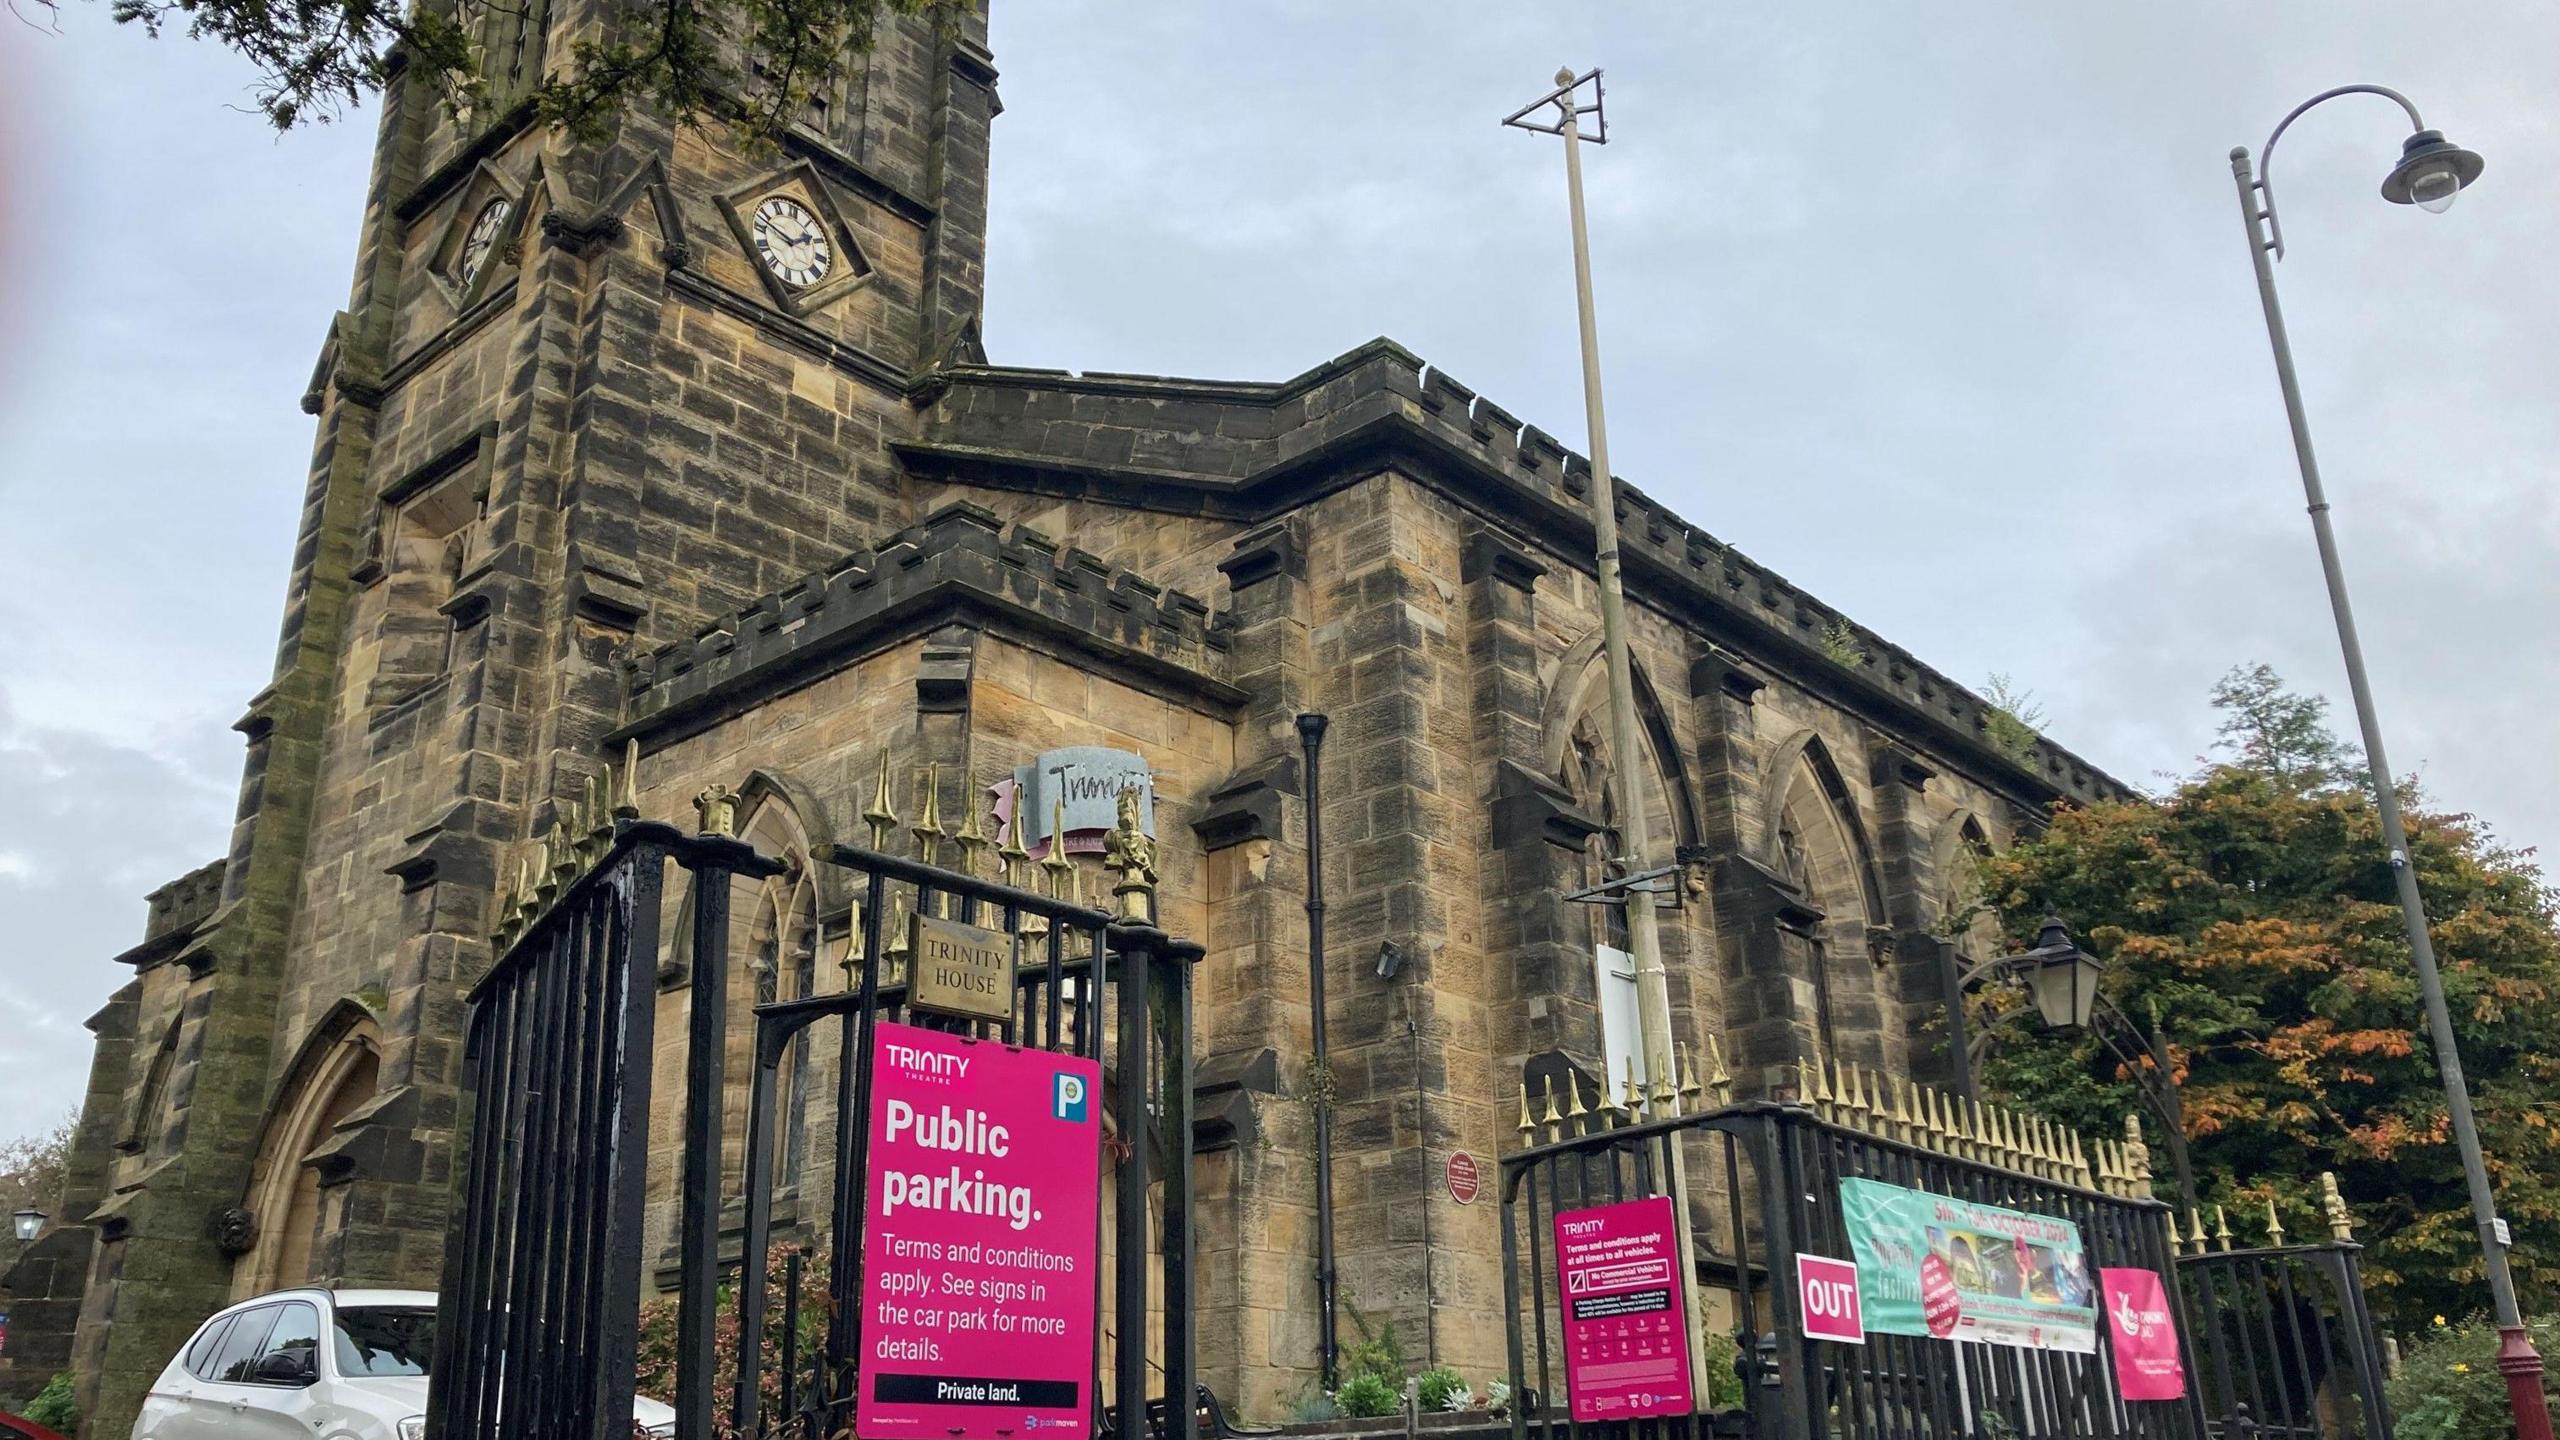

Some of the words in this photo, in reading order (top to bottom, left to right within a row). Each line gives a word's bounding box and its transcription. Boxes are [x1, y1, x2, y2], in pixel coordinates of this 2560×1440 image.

[927, 939, 1005, 970] TRINITY
[935, 968, 997, 995] HOUSE
[886, 1044, 970, 1078] TRINITY
[905, 1072, 951, 1085] THEATRE
[1058, 1074, 1083, 1118] P
[885, 1099, 1010, 1158] Public
[882, 1166, 1042, 1231] parking.
[1563, 1219, 1604, 1236] TRINITY
[1566, 1244, 1588, 1254] Terms
[1589, 1240, 1602, 1250] and
[1603, 1236, 1640, 1248] conditions
[1641, 1232, 1661, 1244] apply
[881, 1233, 942, 1260] Terms
[947, 1241, 981, 1264] and
[985, 1244, 1074, 1273] conditions
[1567, 1258, 1574, 1266] at
[1575, 1256, 1584, 1264] all
[1585, 1254, 1605, 1263] times
[1605, 1252, 1613, 1260] to
[1614, 1249, 1623, 1259] all
[1624, 1246, 1656, 1258] vehicles.
[880, 1269, 936, 1298] apply.
[941, 1272, 975, 1297] See
[979, 1276, 1026, 1304] signs
[1031, 1280, 1046, 1301] in
[1591, 1272, 1600, 1280] No
[1600, 1267, 1636, 1279] Commercial
[1637, 1264, 1663, 1274] Vehicles
[1807, 1278, 1853, 1320] OUT
[878, 1301, 909, 1325] the
[913, 1308, 944, 1328] car
[948, 1306, 988, 1333] park
[992, 1309, 1017, 1332] for
[1021, 1315, 1066, 1335] more
[876, 1335, 944, 1362] details.
[937, 1382, 985, 1401] Private
[988, 1384, 1020, 1402] land.
